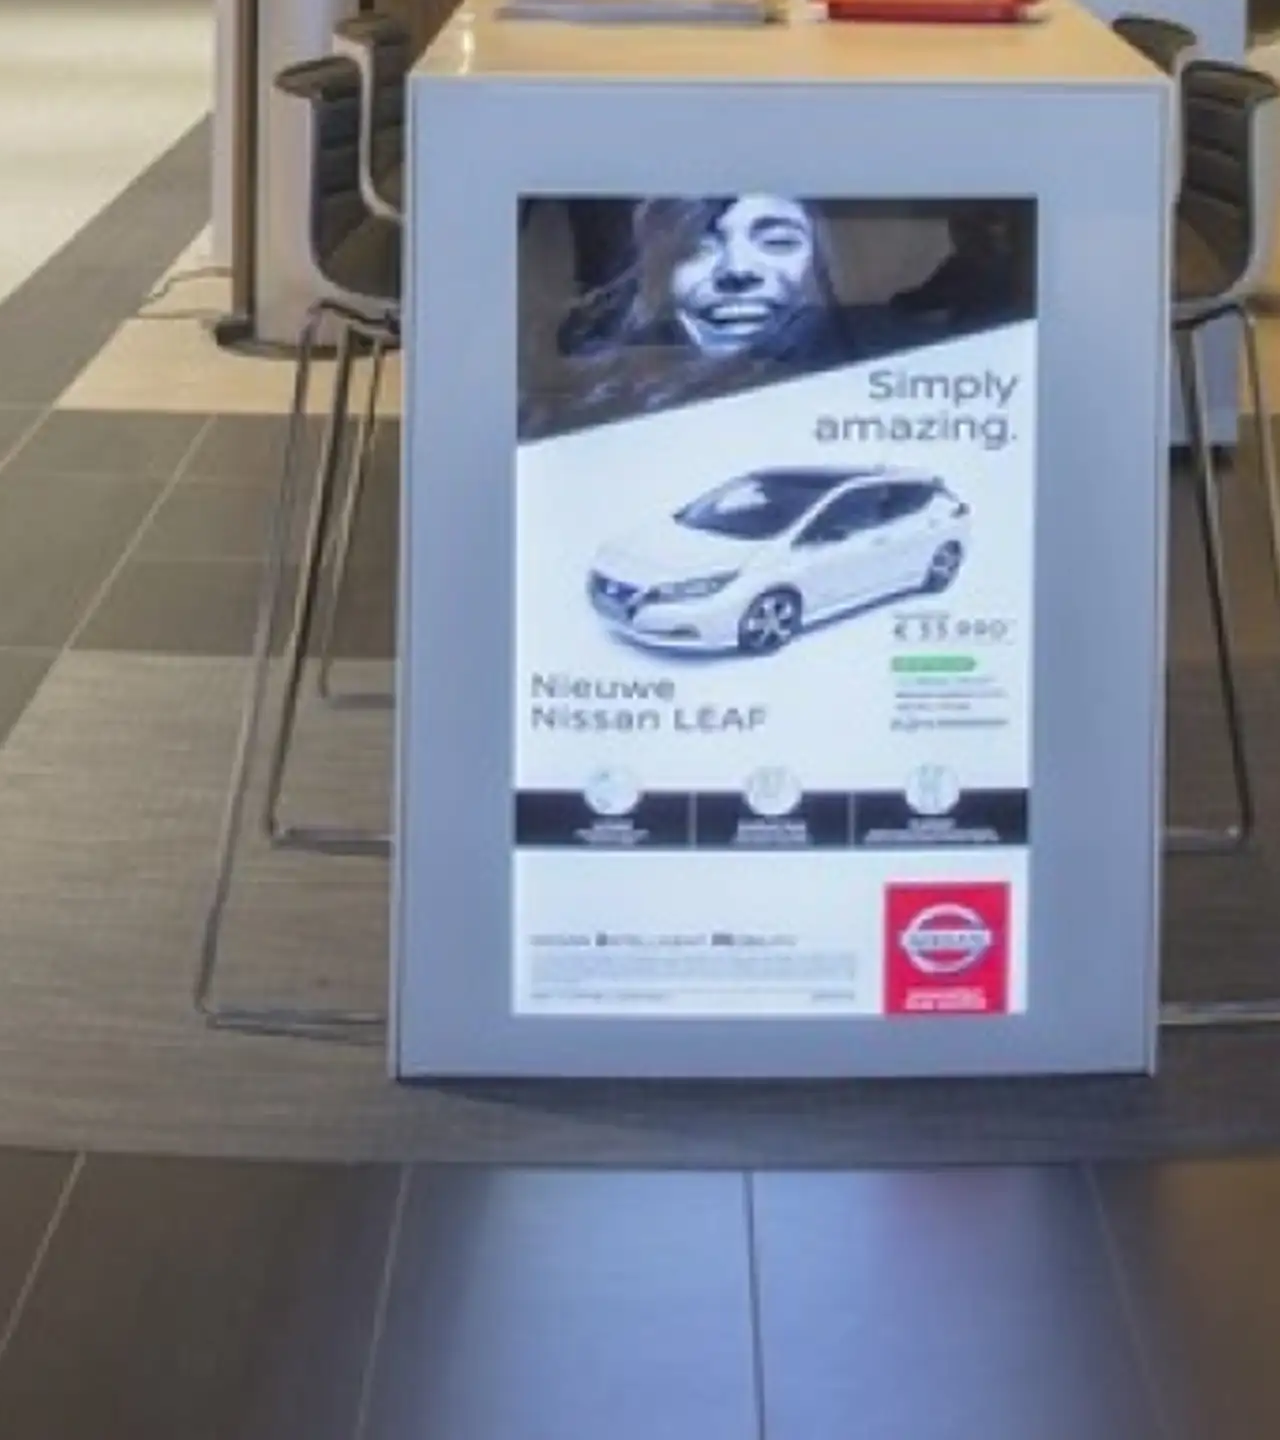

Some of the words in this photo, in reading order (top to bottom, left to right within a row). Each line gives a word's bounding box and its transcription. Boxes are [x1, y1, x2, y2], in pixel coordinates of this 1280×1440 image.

[868, 369, 1018, 407] Simply
[814, 412, 1017, 450] amazing.
[531, 672, 675, 700] Nieuwe
[531, 705, 661, 731] Nissan
[673, 704, 766, 732] LEAF
